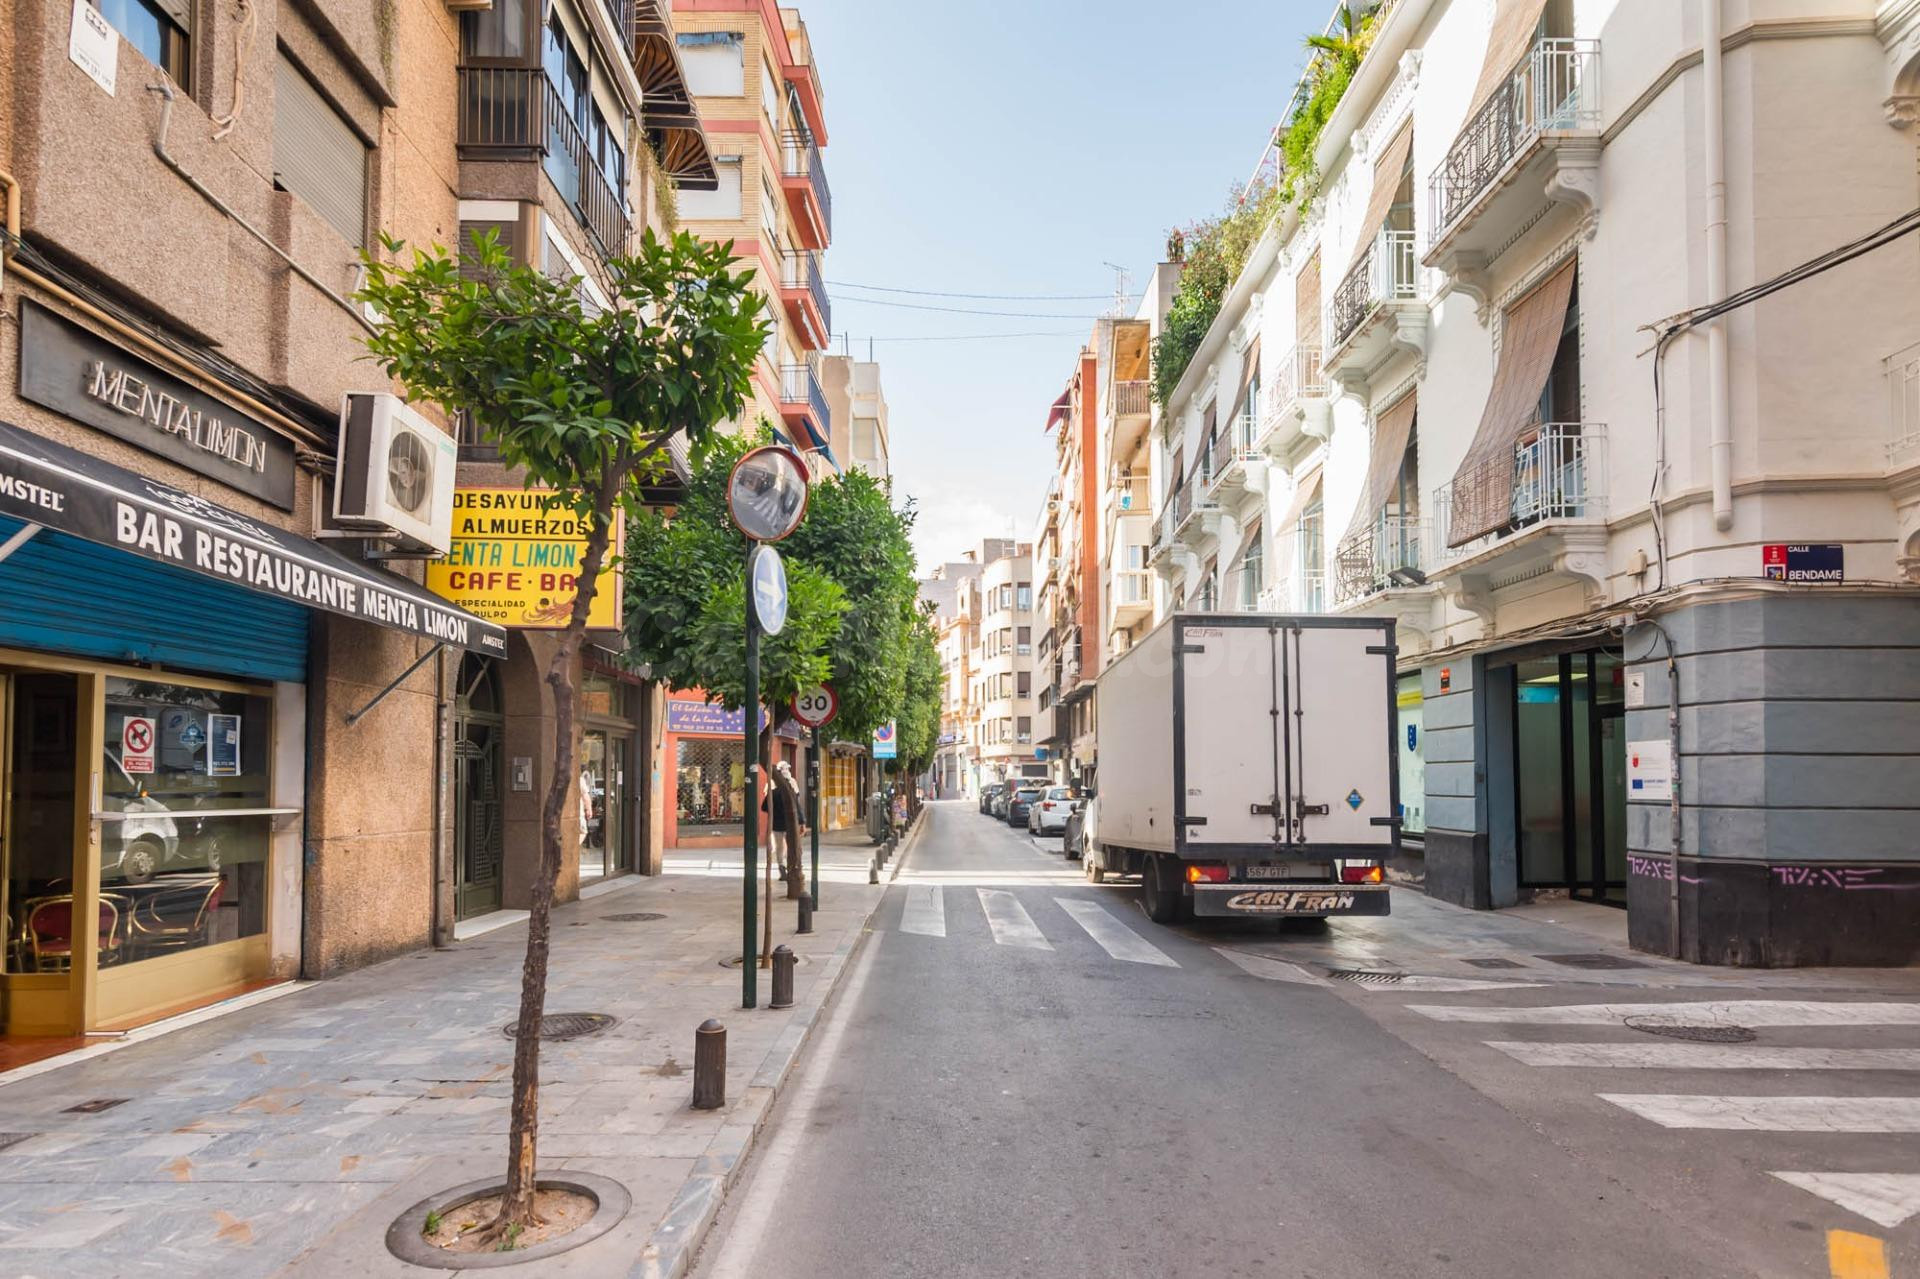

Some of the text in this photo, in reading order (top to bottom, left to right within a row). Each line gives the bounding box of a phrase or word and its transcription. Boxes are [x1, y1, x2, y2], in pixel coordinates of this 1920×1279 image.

[0, 472, 65, 513] MSTEL
[462, 518, 588, 535] ALMUERZOS
[431, 540, 576, 567] ENTA LIMON
[116, 501, 184, 561] BAR
[196, 530, 356, 613] RESTAURANTE
[363, 587, 418, 630] MENTA
[423, 607, 468, 644] LIMON
[1788, 570, 1842, 580] BENDAME
[449, 571, 576, 592] CAFE BA
[455, 599, 526, 607] ESPECIALIDAD
[481, 633, 505, 650] AMSTEL
[801, 695, 827, 711] 30
